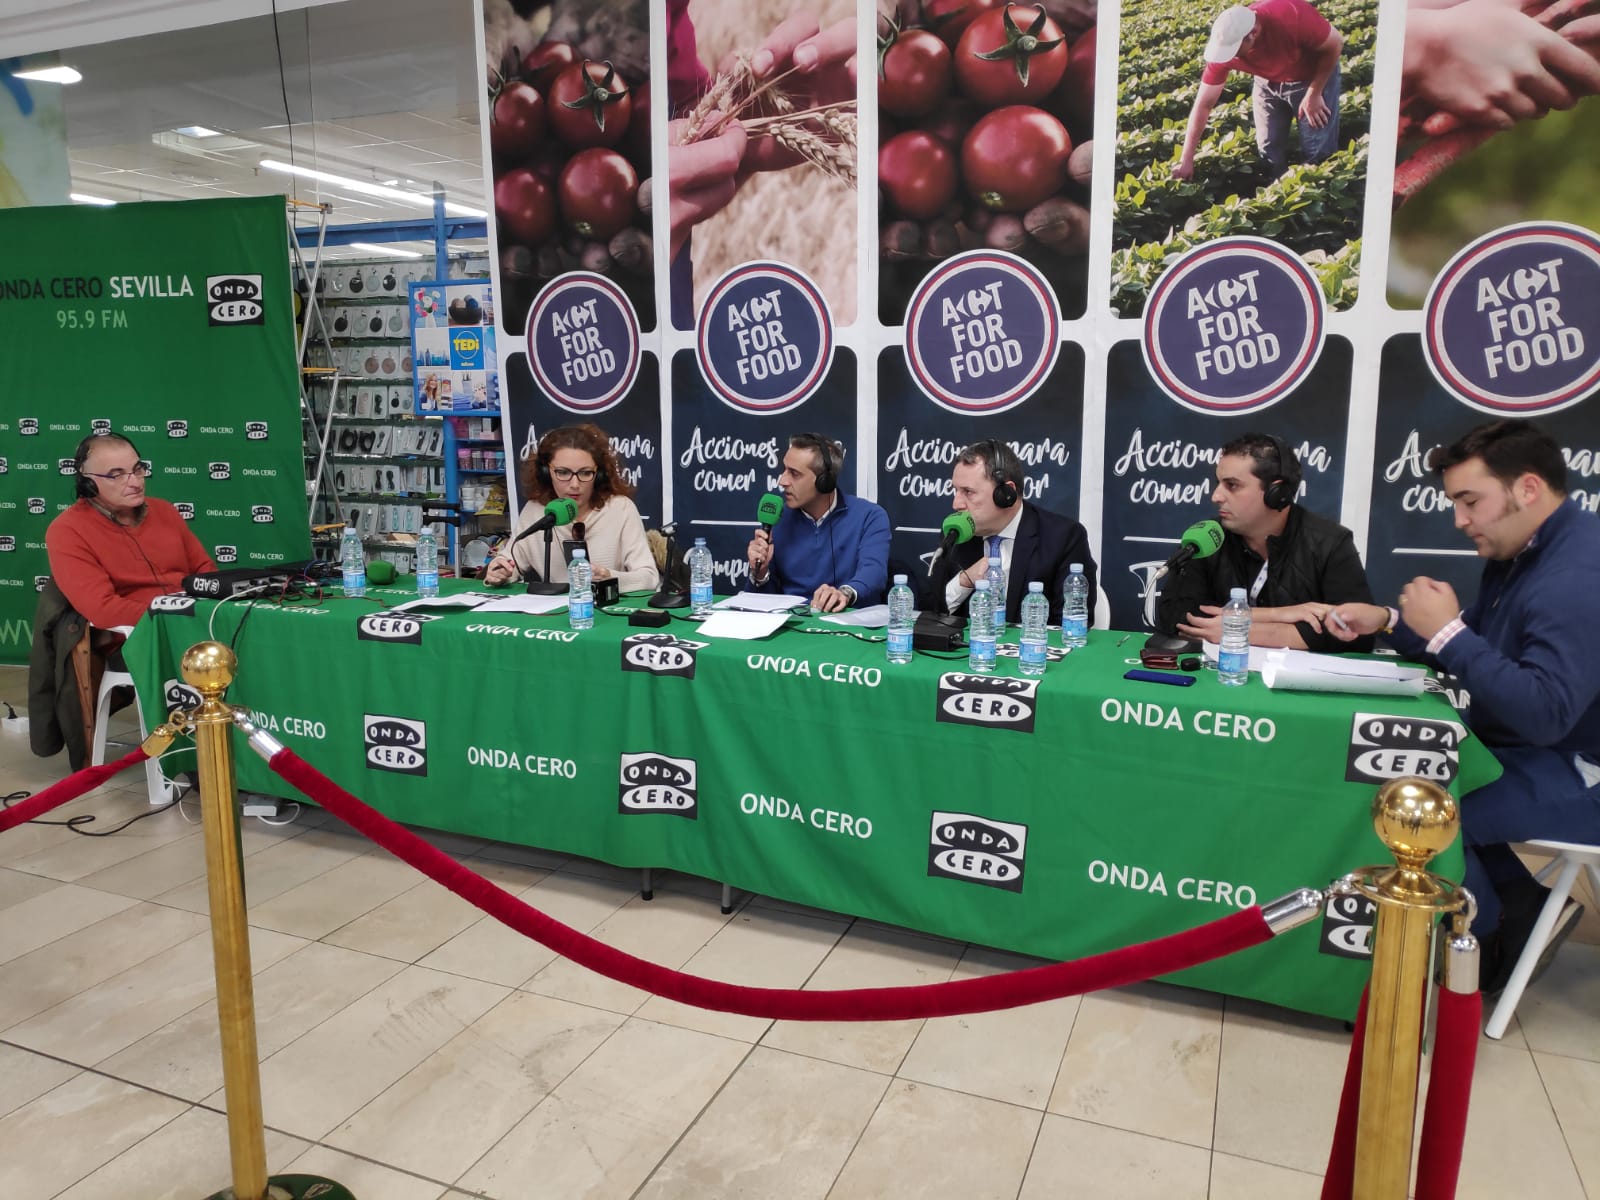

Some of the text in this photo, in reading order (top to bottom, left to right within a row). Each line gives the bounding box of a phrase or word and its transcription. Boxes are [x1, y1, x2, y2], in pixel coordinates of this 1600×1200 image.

[50, 276, 103, 299] CERO
[109, 275, 194, 299] SEVILLA
[214, 285, 255, 296] ONDA
[56, 310, 128, 329] 95.9 FM
[218, 305, 257, 318] CERO
[1488, 297, 1565, 343] FOR
[736, 320, 788, 357] FOR
[951, 314, 1007, 353] FOR
[1198, 305, 1264, 348] FOR
[560, 326, 603, 360] FOR
[1484, 326, 1585, 379] FOOD
[561, 348, 616, 386] FOOD
[736, 343, 802, 385] FOOD
[950, 339, 1023, 384] FOOD
[1195, 333, 1281, 381] FOOD
[680, 425, 779, 468] Acciones
[694, 469, 756, 492] comer
[900, 474, 956, 497] come
[1130, 478, 1209, 505] comer
[369, 618, 412, 633] CERO
[466, 623, 581, 643] ONDA CERO
[635, 647, 684, 666] CERO
[747, 654, 882, 687] ONDA CERO
[954, 695, 1021, 719] CERO
[283, 717, 327, 739] CERO
[1101, 698, 1277, 743] ONDA CERO
[370, 726, 416, 742] ONDA
[1369, 721, 1453, 747] ONDA
[374, 748, 417, 766] CERO
[467, 747, 577, 779] ONDA CERO
[628, 765, 686, 784] ONDA
[631, 789, 686, 806] CERO
[740, 793, 873, 839] ONDA CERO
[943, 825, 1011, 850] ONDA
[946, 852, 1010, 878] CERO
[1088, 860, 1256, 909] ONDA CERO
